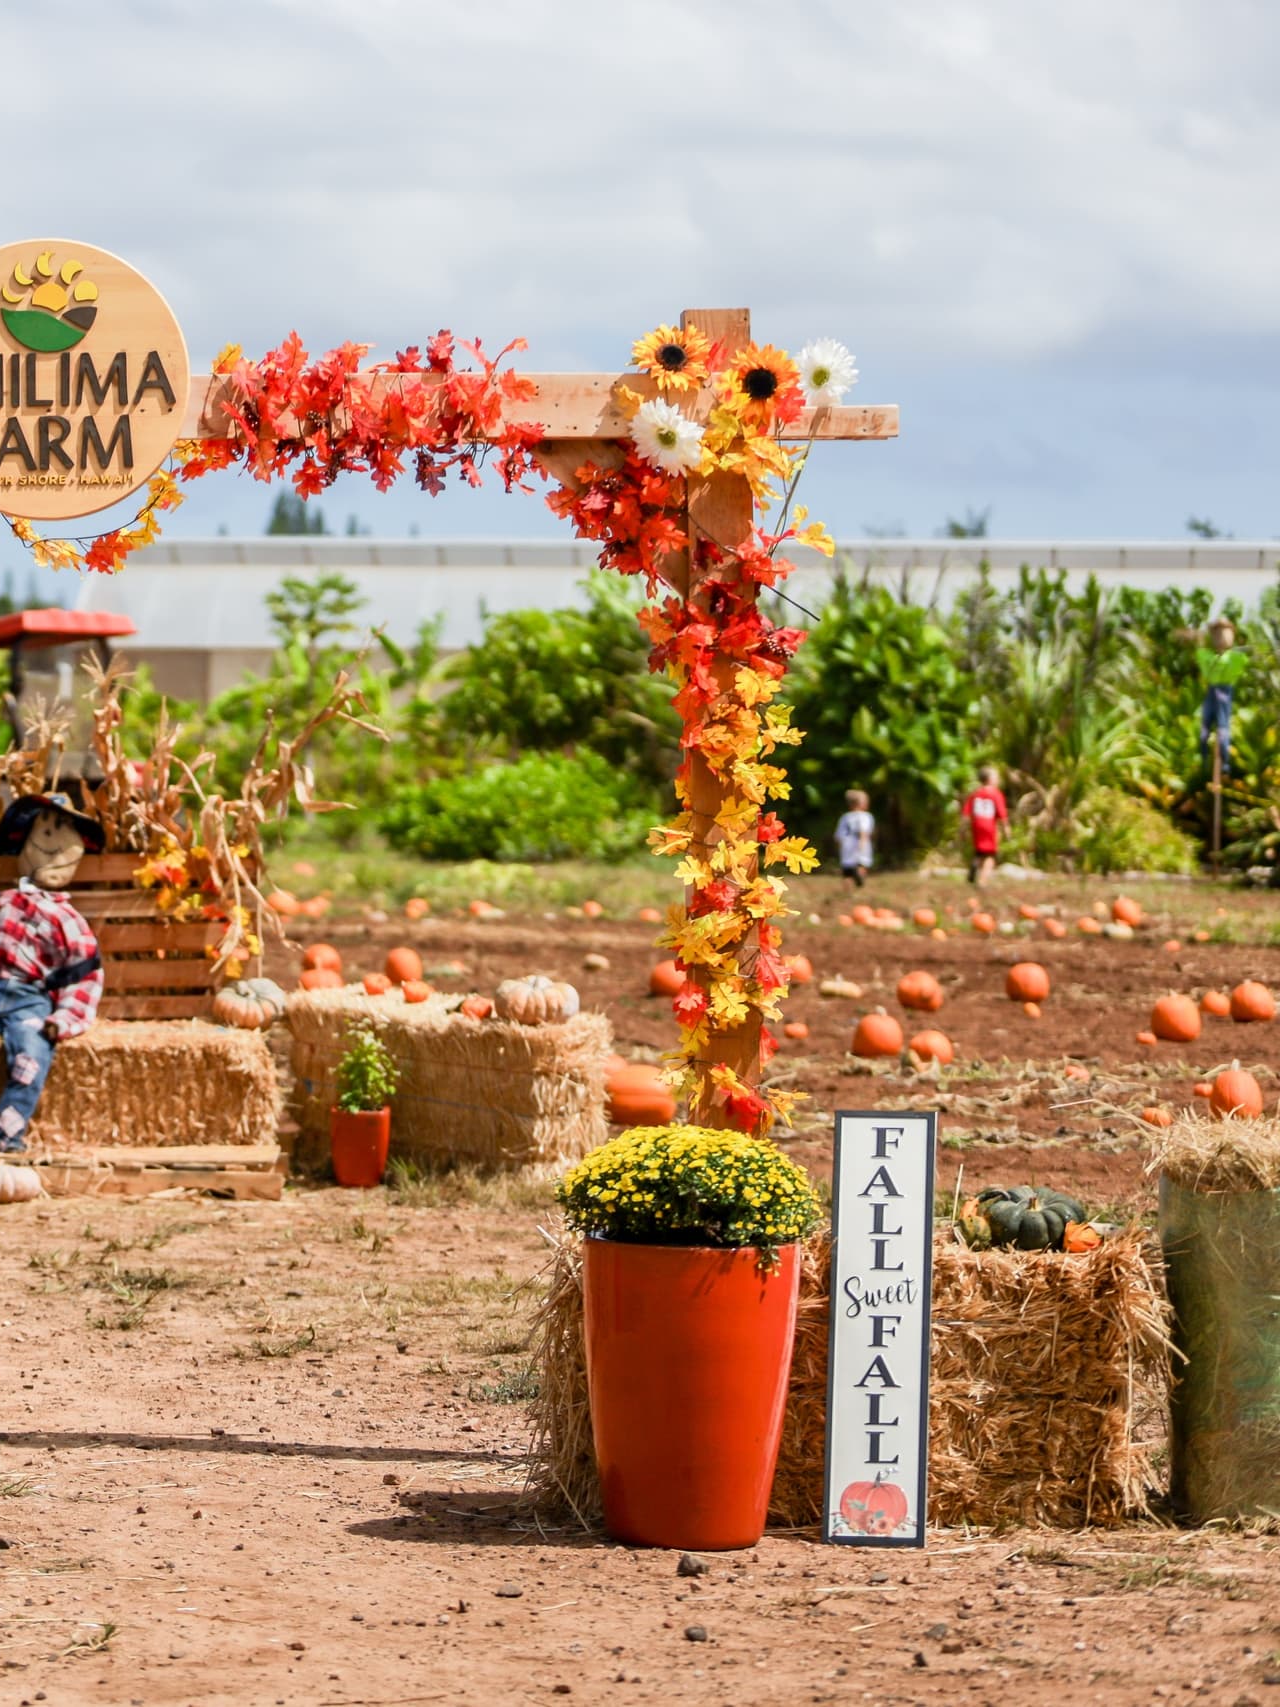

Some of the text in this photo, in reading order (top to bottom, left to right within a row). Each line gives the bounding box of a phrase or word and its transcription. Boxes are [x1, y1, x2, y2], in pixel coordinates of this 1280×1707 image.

[857, 1126, 905, 1272] FALL
[843, 1275, 919, 1318] Sweet
[853, 1315, 902, 1465] FALL
